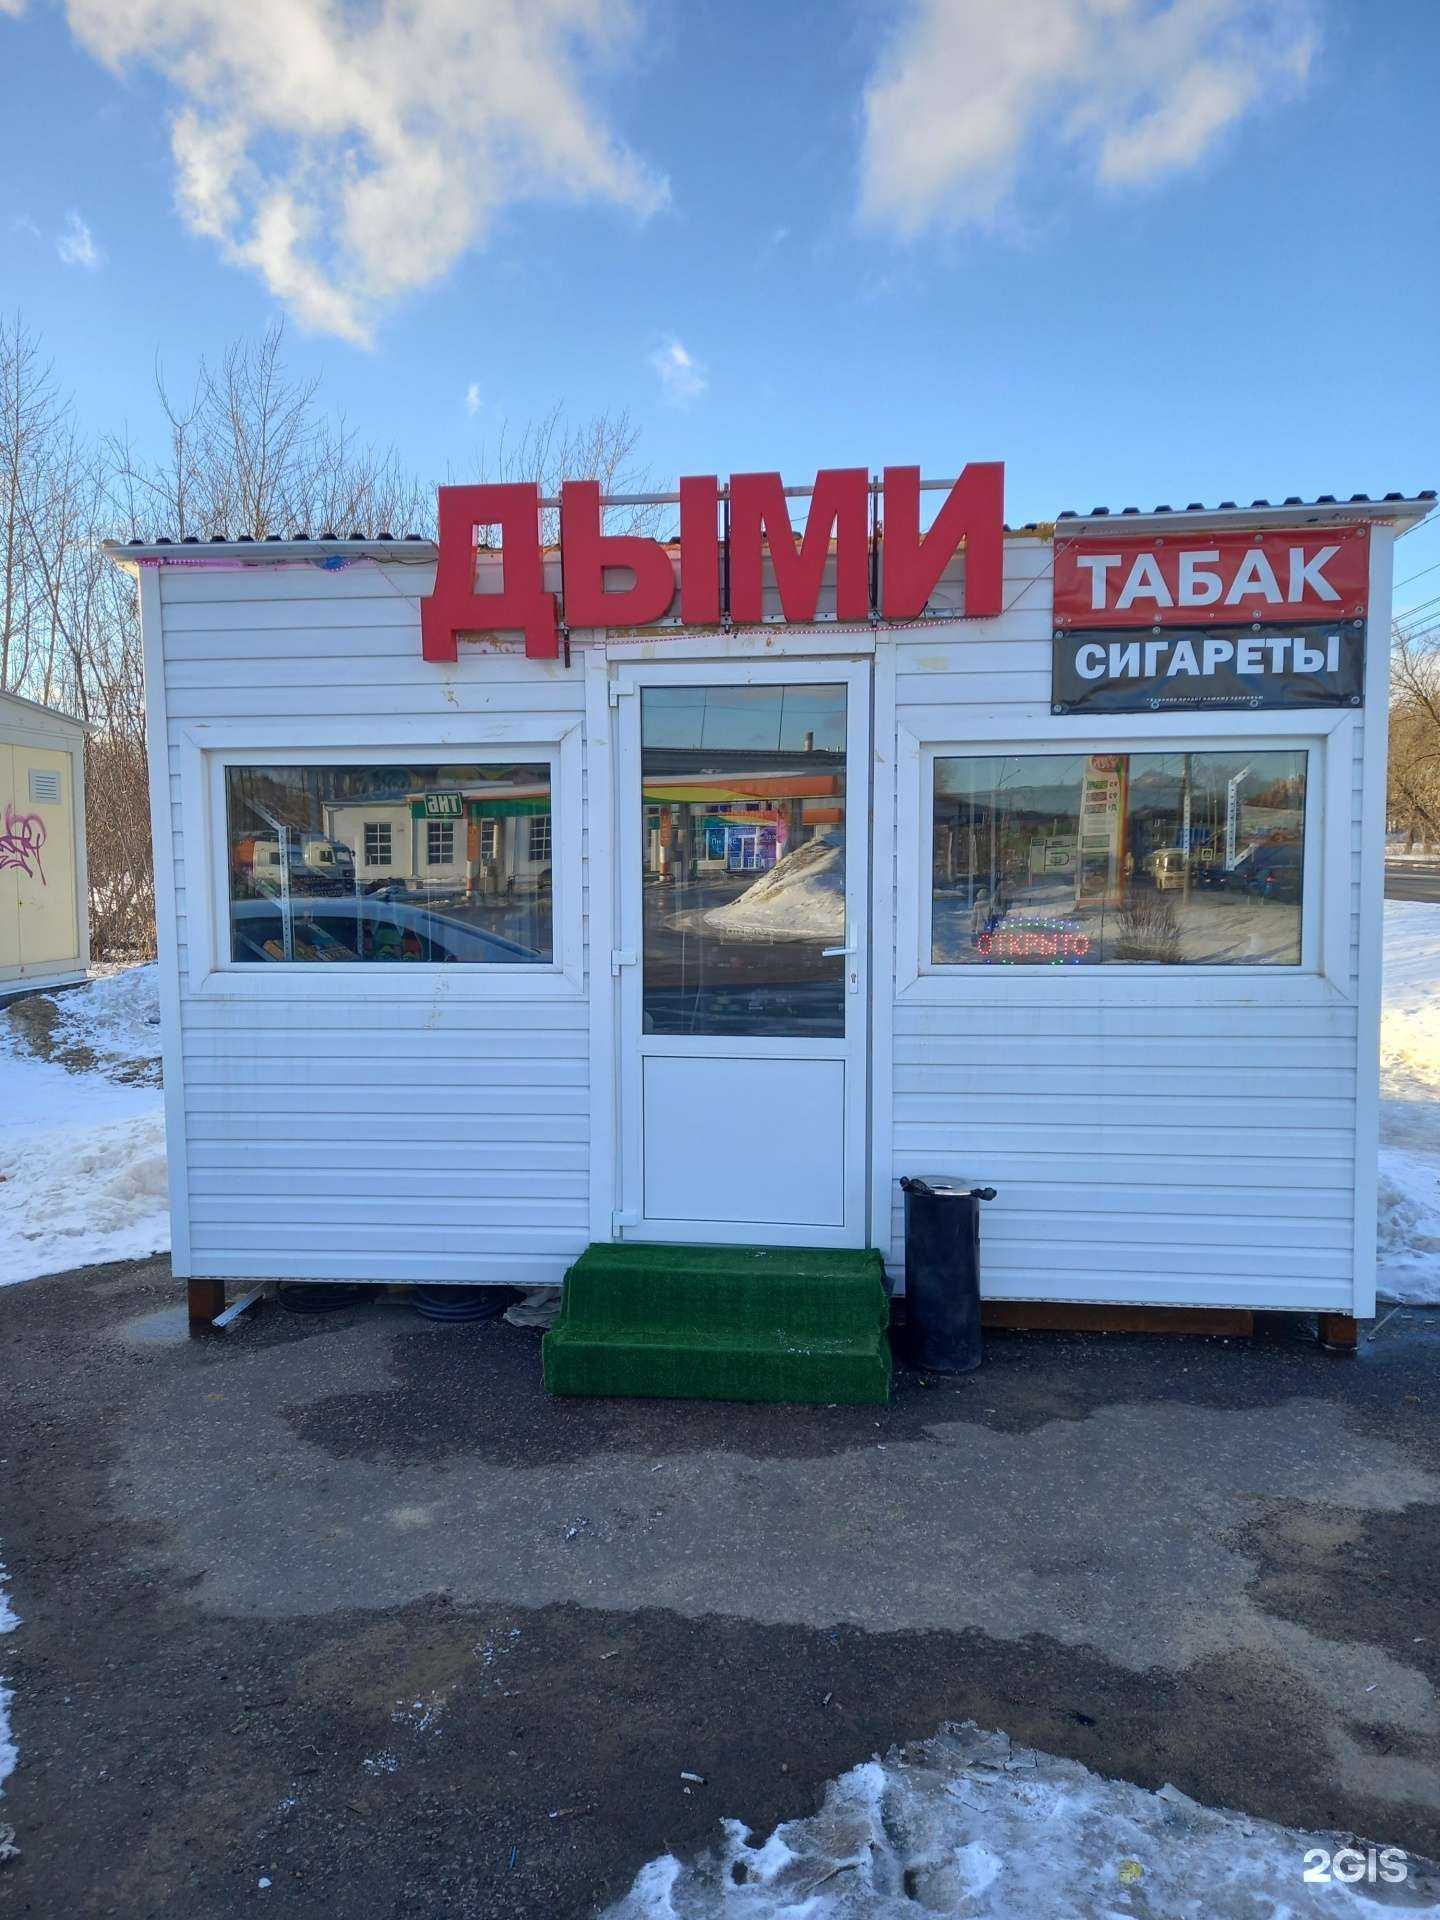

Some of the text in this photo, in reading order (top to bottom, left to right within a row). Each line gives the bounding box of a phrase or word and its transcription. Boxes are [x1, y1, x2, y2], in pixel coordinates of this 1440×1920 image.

[420, 461, 1006, 662] ДЫМИ
[1077, 545, 1343, 610] ТАБАК
[1075, 636, 1341, 680] СИГАРЕТЫ
[977, 933, 1089, 956] ОТКРЫТО
